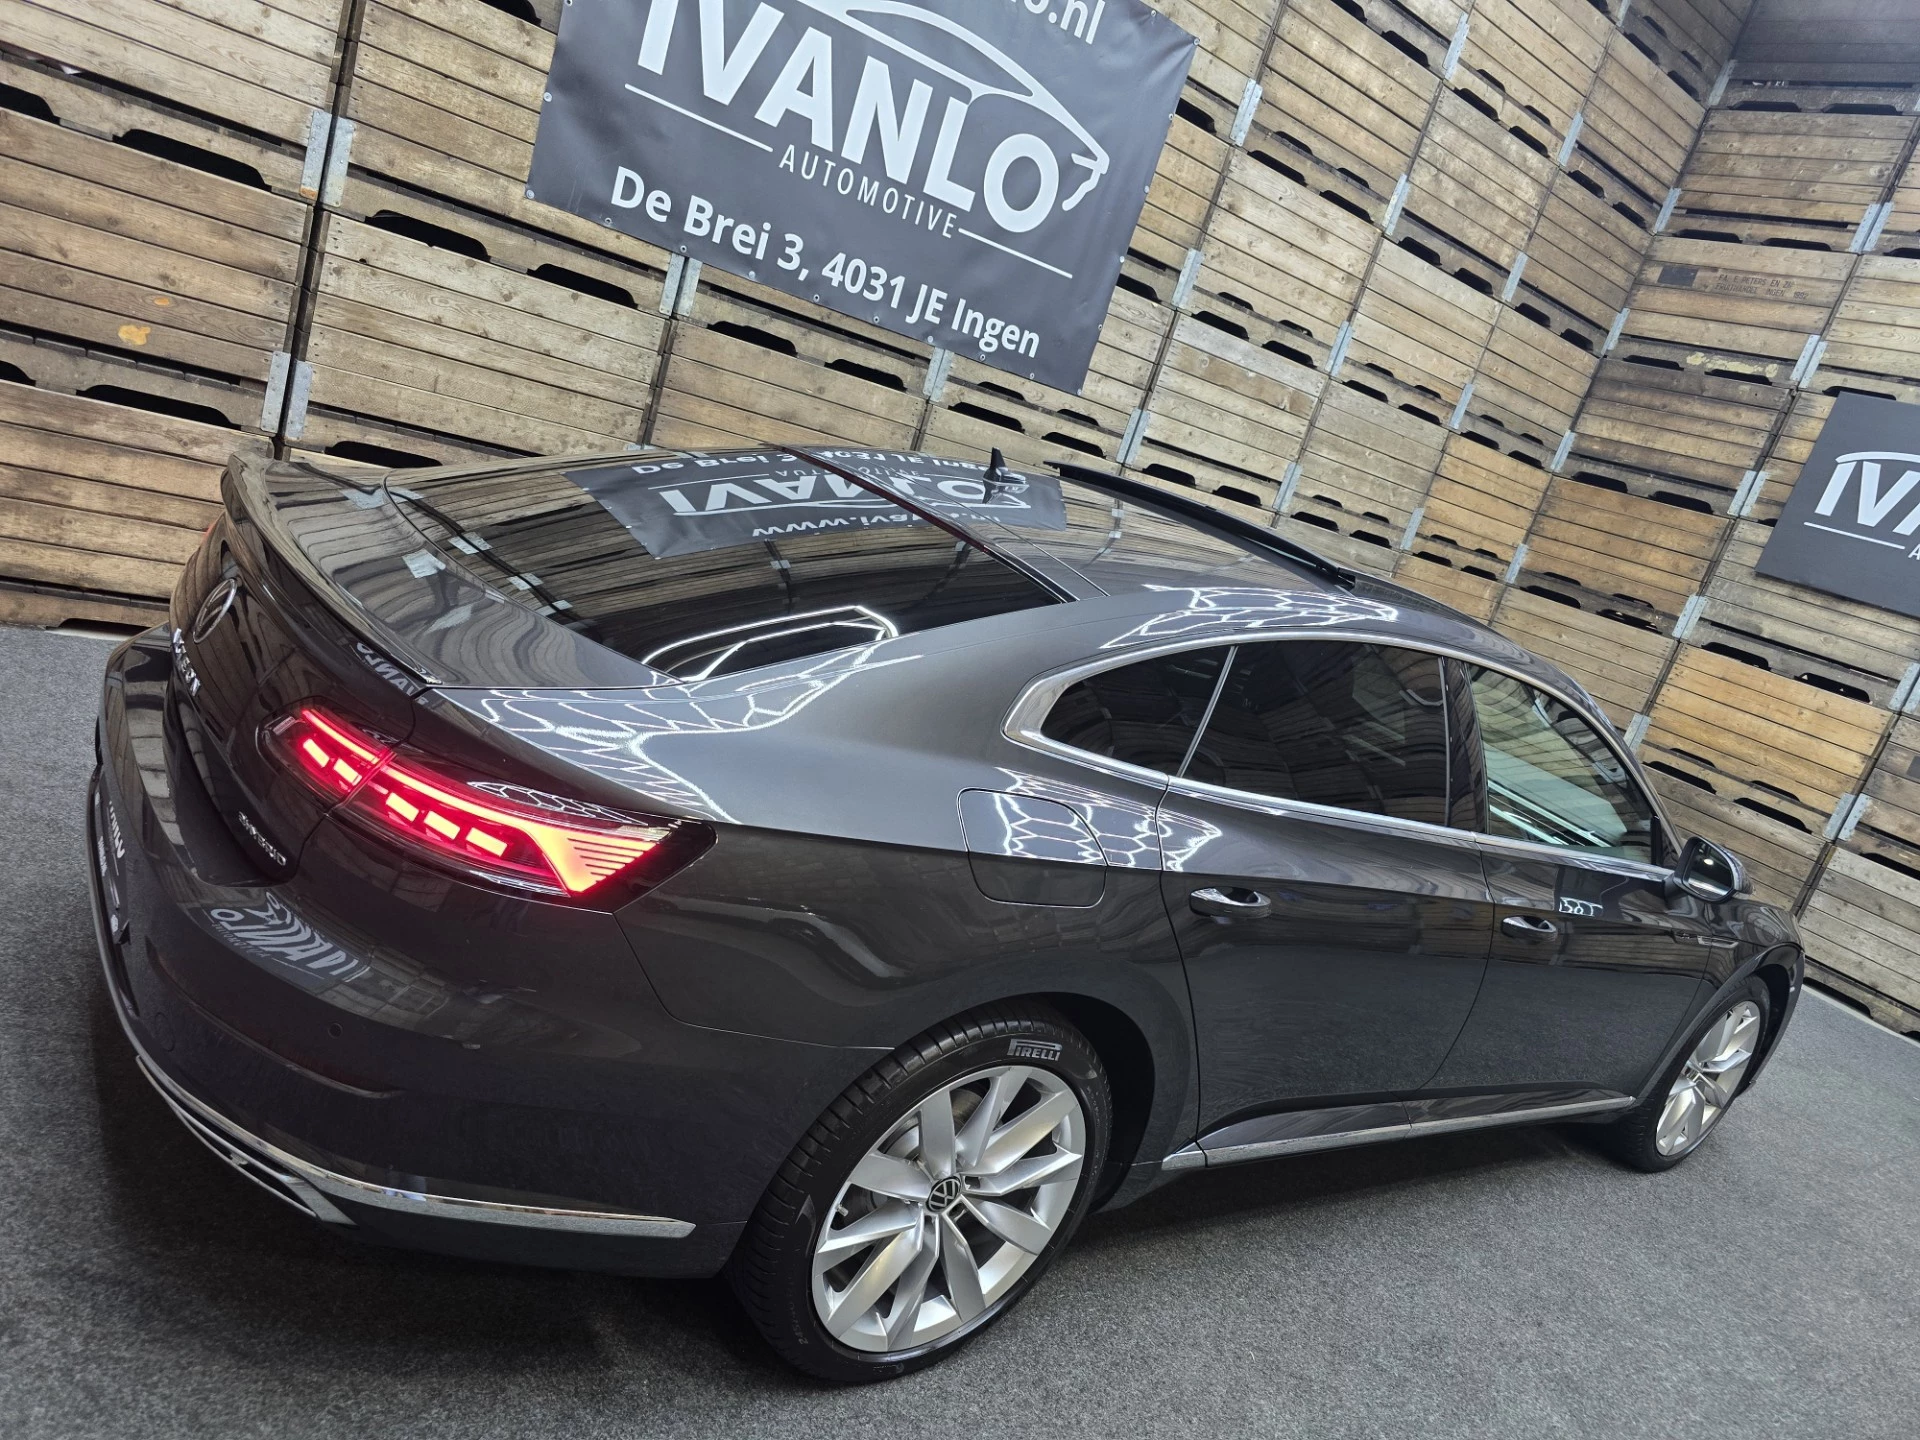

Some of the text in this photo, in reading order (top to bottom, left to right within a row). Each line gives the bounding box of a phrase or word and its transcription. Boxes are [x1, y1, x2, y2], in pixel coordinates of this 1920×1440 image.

[638, 0, 1060, 233] IVANLO
[610, 166, 1040, 358] De Brei 3, 4031 JE Ingen
[778, 144, 958, 239] AUTOMOTIVE
[1006, 1038, 1063, 1062] PIRELLI
